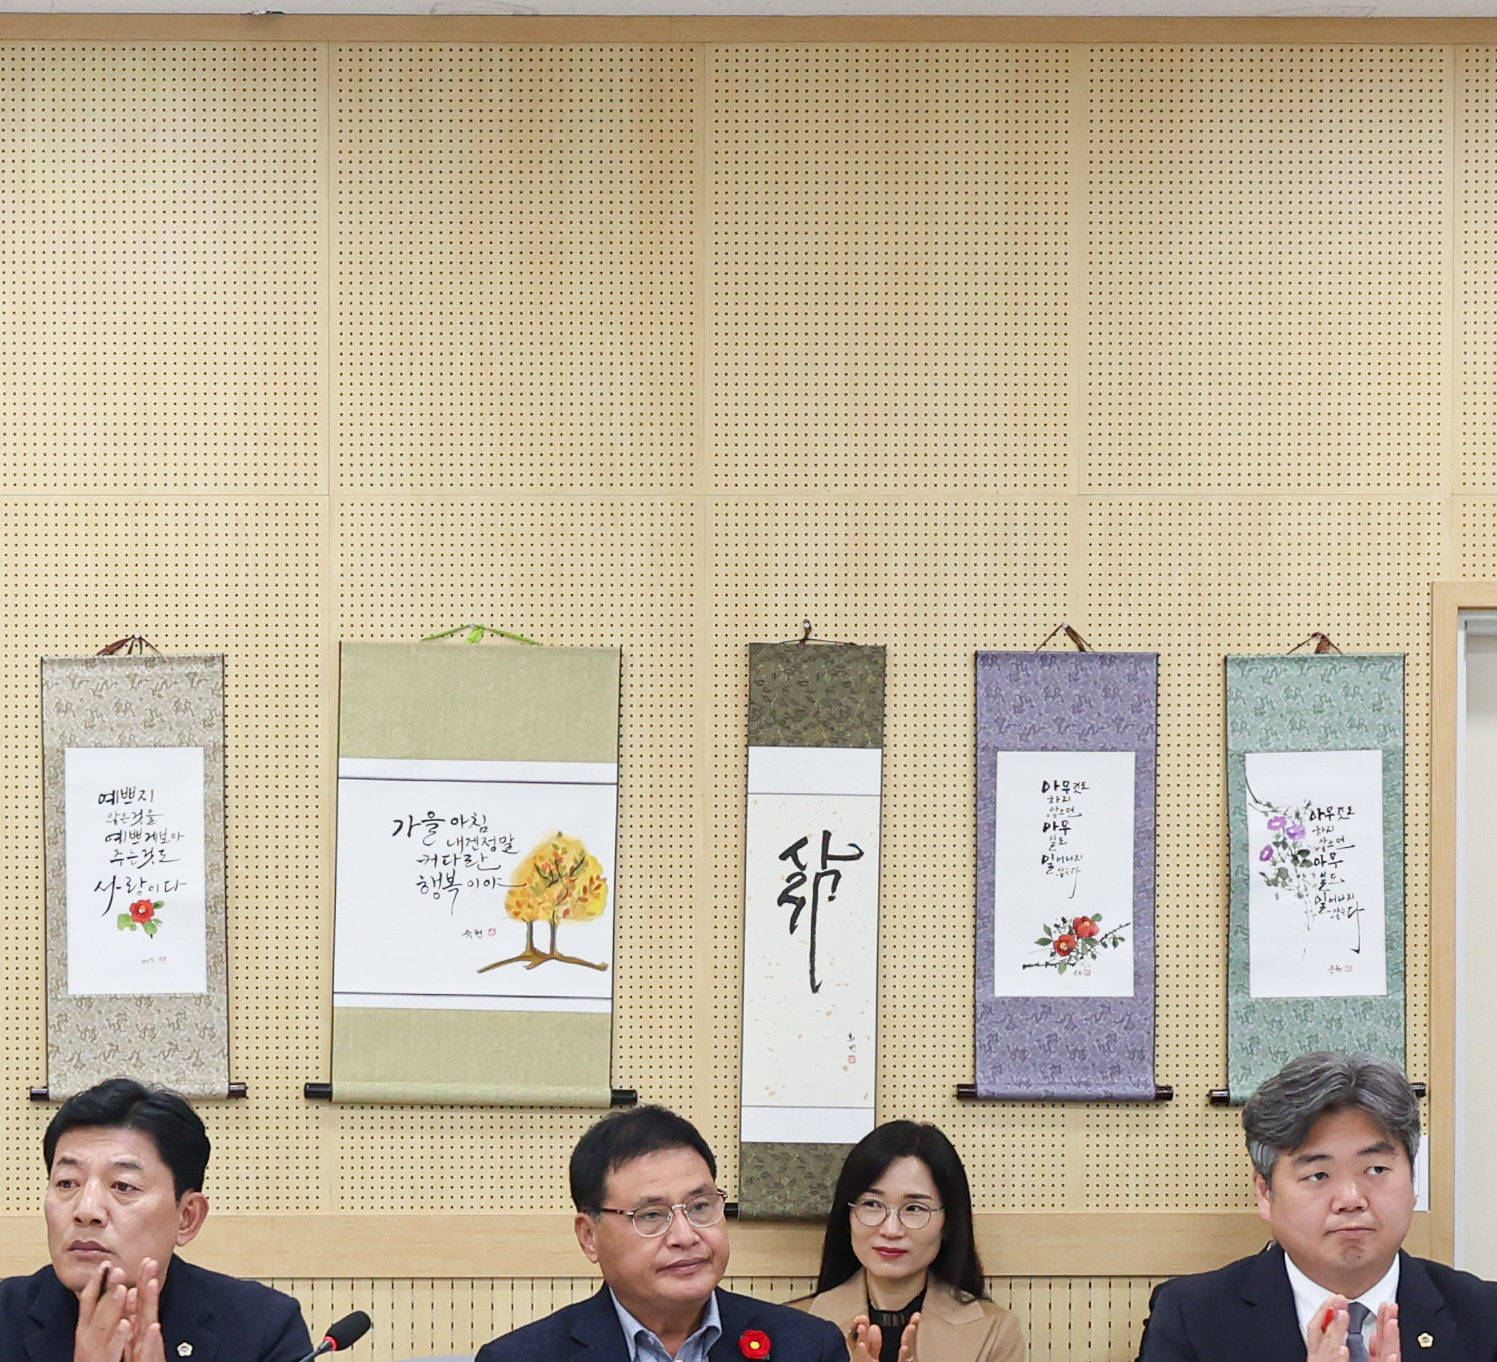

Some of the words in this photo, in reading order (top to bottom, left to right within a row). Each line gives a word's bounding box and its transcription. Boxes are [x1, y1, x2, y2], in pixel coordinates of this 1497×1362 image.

[98, 786, 154, 805] 예쁘지
[392, 811, 446, 846] 가을
[450, 812, 489, 833] 아침
[416, 852, 502, 870] 커다란
